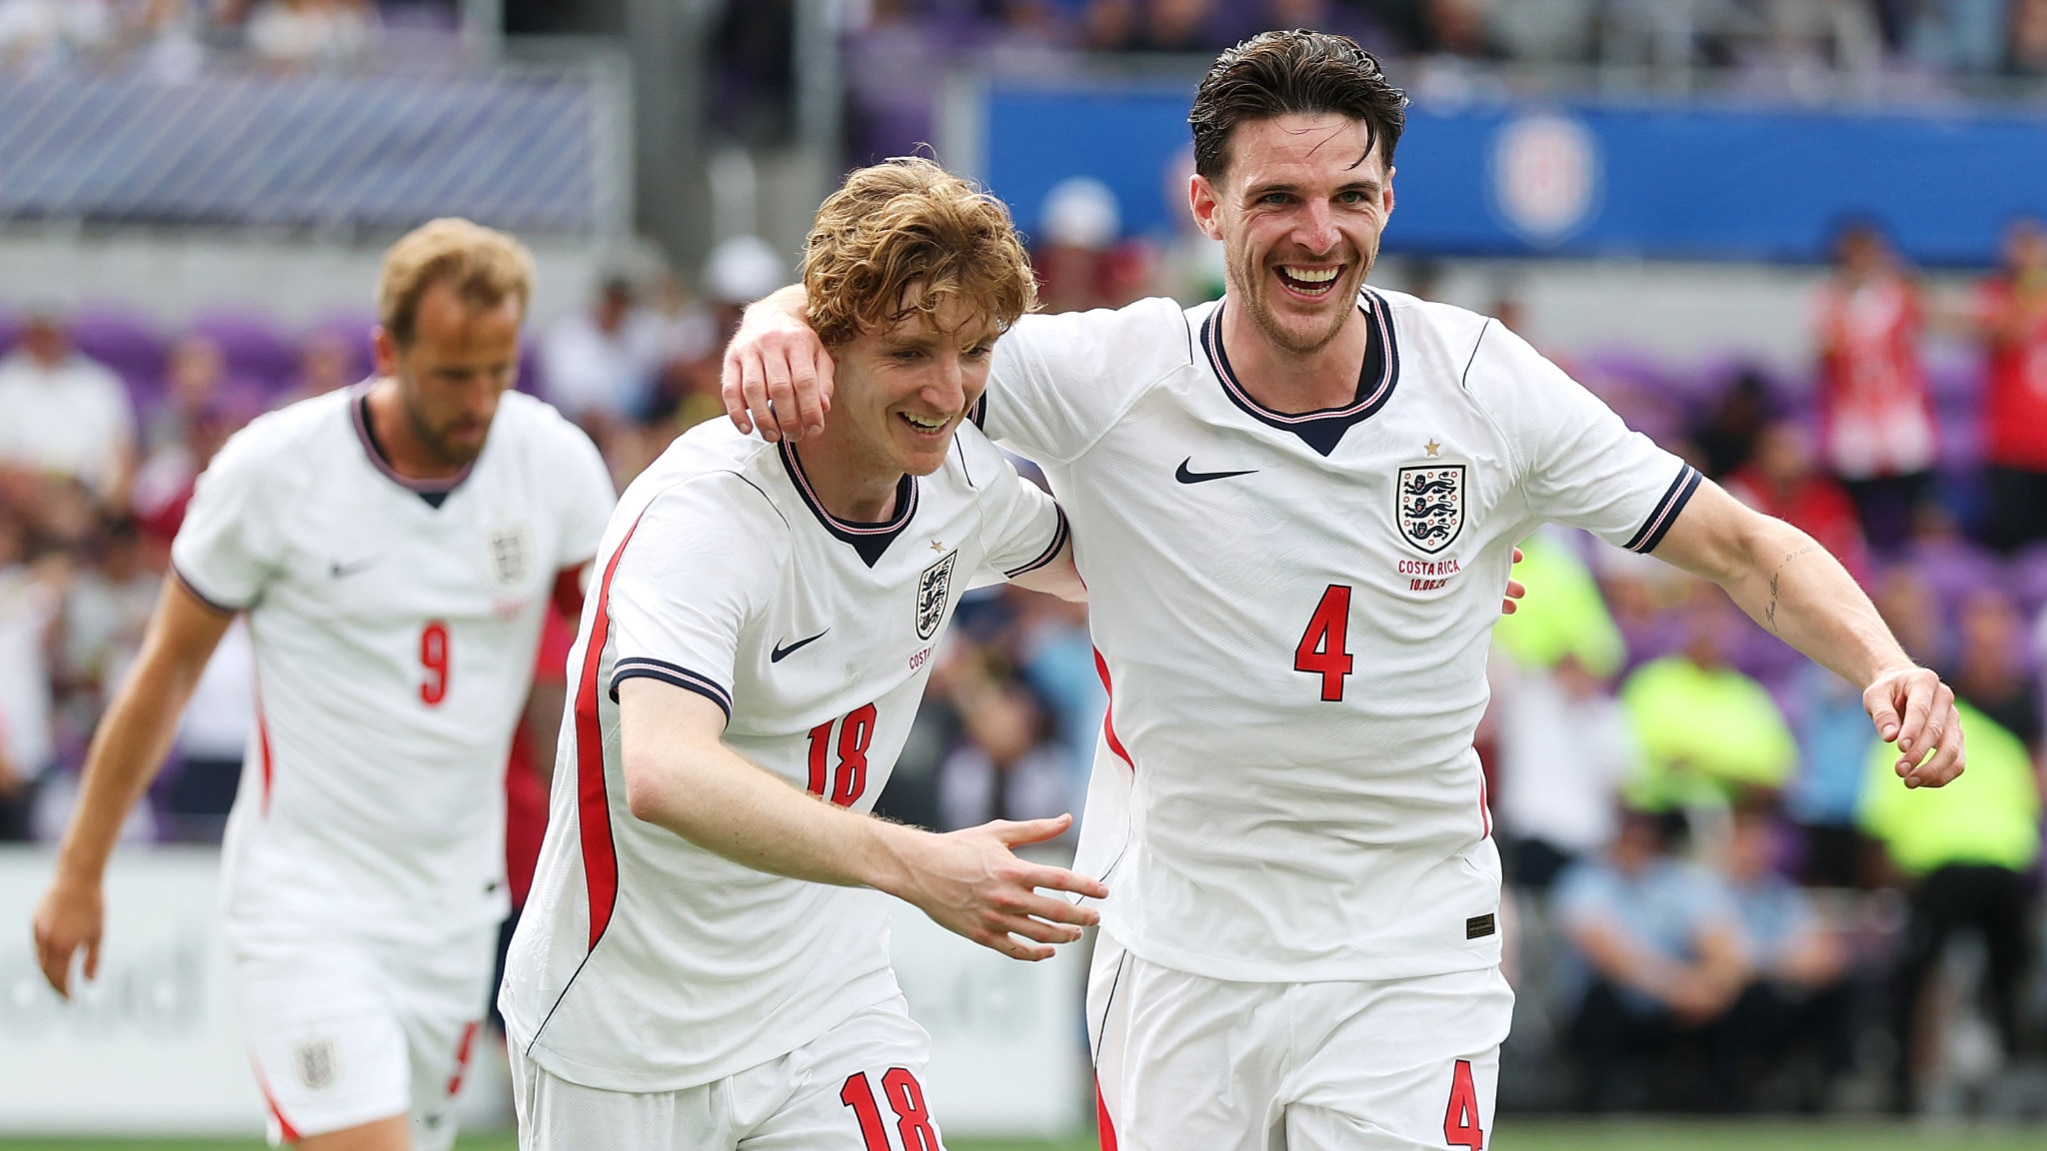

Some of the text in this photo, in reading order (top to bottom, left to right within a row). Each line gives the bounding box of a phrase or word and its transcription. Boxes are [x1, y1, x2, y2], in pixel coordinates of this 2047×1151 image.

[1399, 559, 1461, 576] COSTA RICA
[419, 619, 449, 707] 9
[1294, 584, 1353, 702] 4
[808, 702, 878, 807] 18
[840, 1067, 940, 1151] 18
[1443, 1059, 1483, 1151] 4
